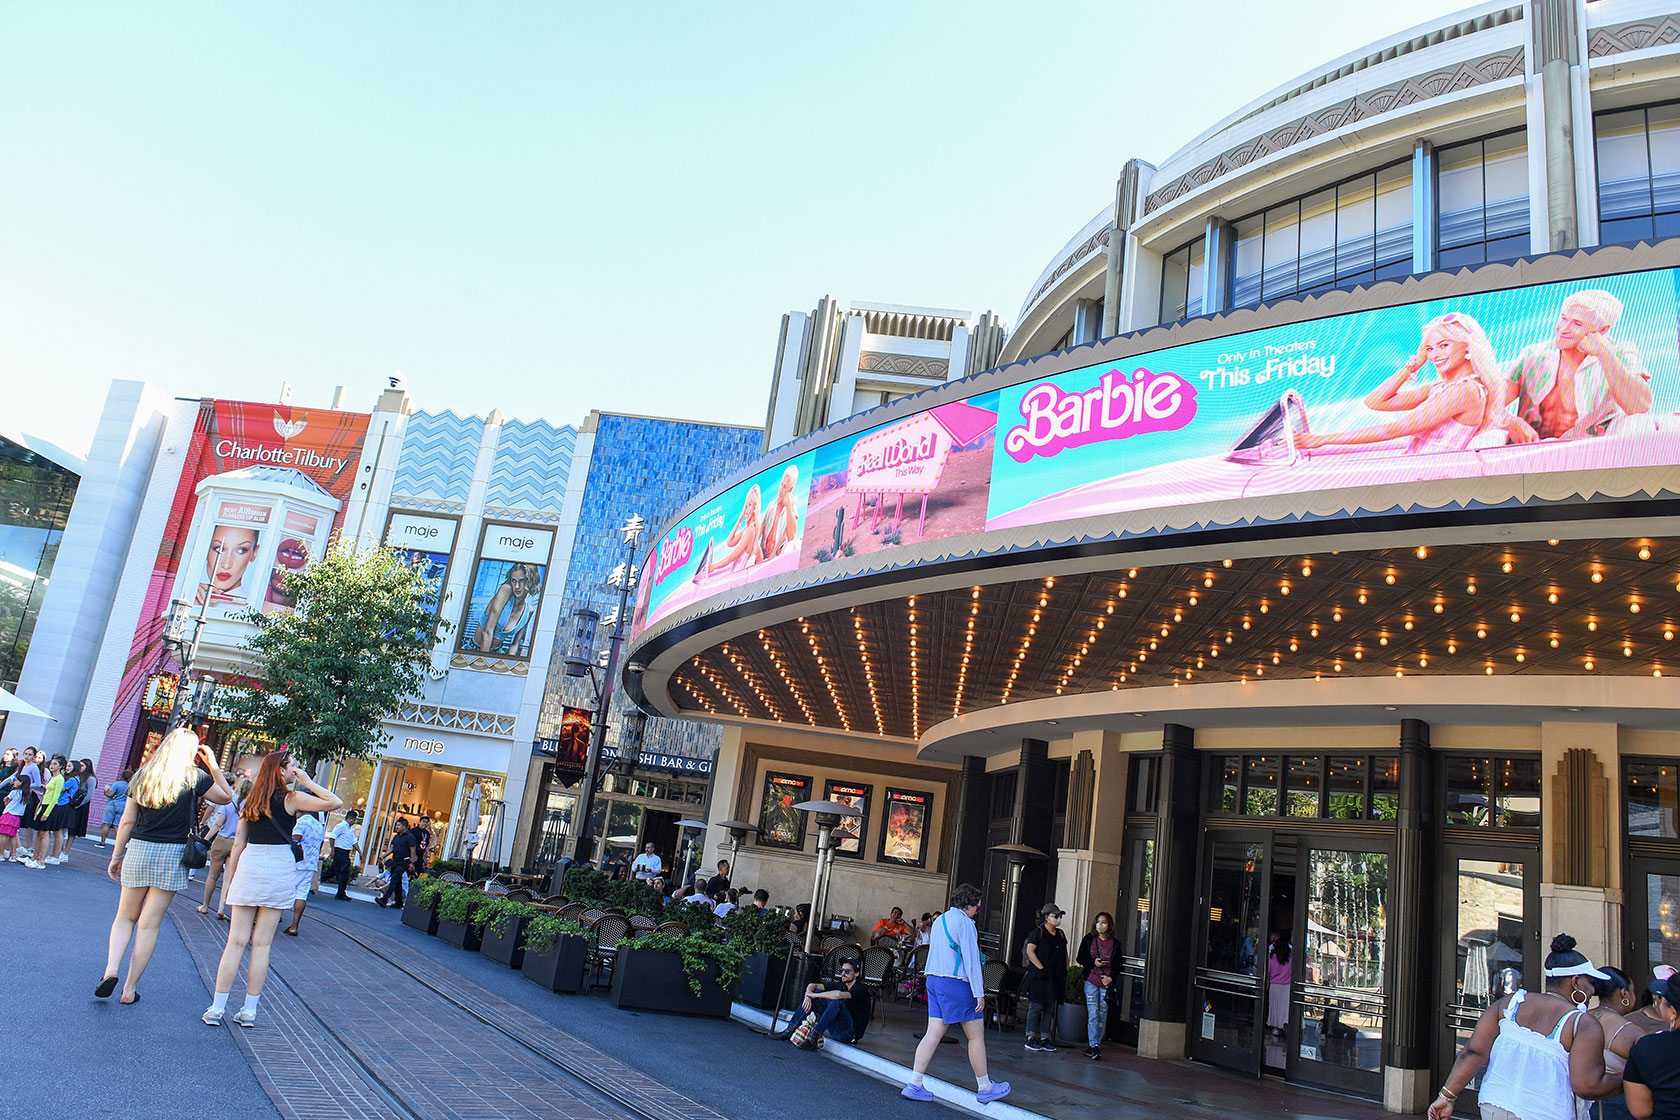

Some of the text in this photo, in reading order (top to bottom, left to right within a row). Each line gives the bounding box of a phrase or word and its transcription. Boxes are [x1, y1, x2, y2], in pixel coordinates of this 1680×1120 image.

[1218, 340, 1317, 365] Only In Theaters
[1199, 352, 1336, 391] This Friday
[1007, 371, 1181, 453] Barbie
[856, 433, 937, 477] Real World
[895, 465, 925, 478] This Way
[404, 524, 439, 538] maje
[499, 534, 534, 549] maje
[655, 526, 693, 583] Barbie
[404, 737, 444, 754] maje
[661, 758, 683, 769] BAR
[686, 761, 696, 771] &
